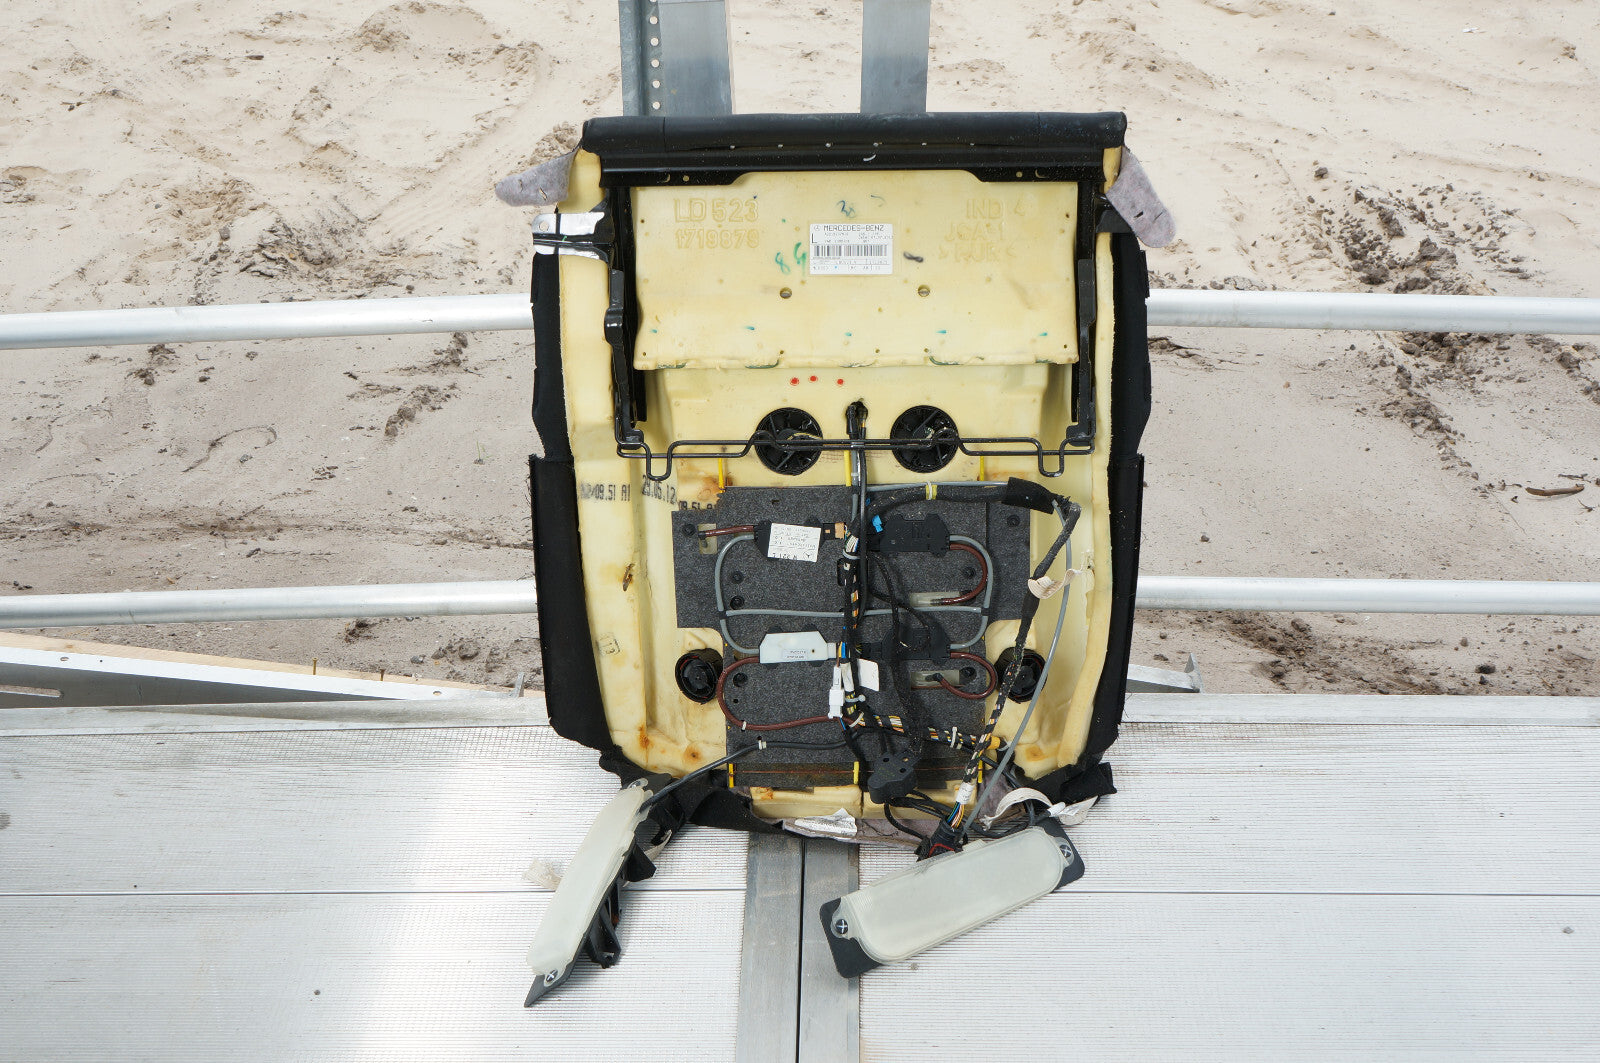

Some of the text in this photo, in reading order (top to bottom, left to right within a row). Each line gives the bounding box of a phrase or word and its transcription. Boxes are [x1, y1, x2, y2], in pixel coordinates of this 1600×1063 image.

[673, 198, 759, 223] LD 523
[966, 199, 1004, 219] IND
[823, 224, 884, 232] MERCEDES-BENZ
